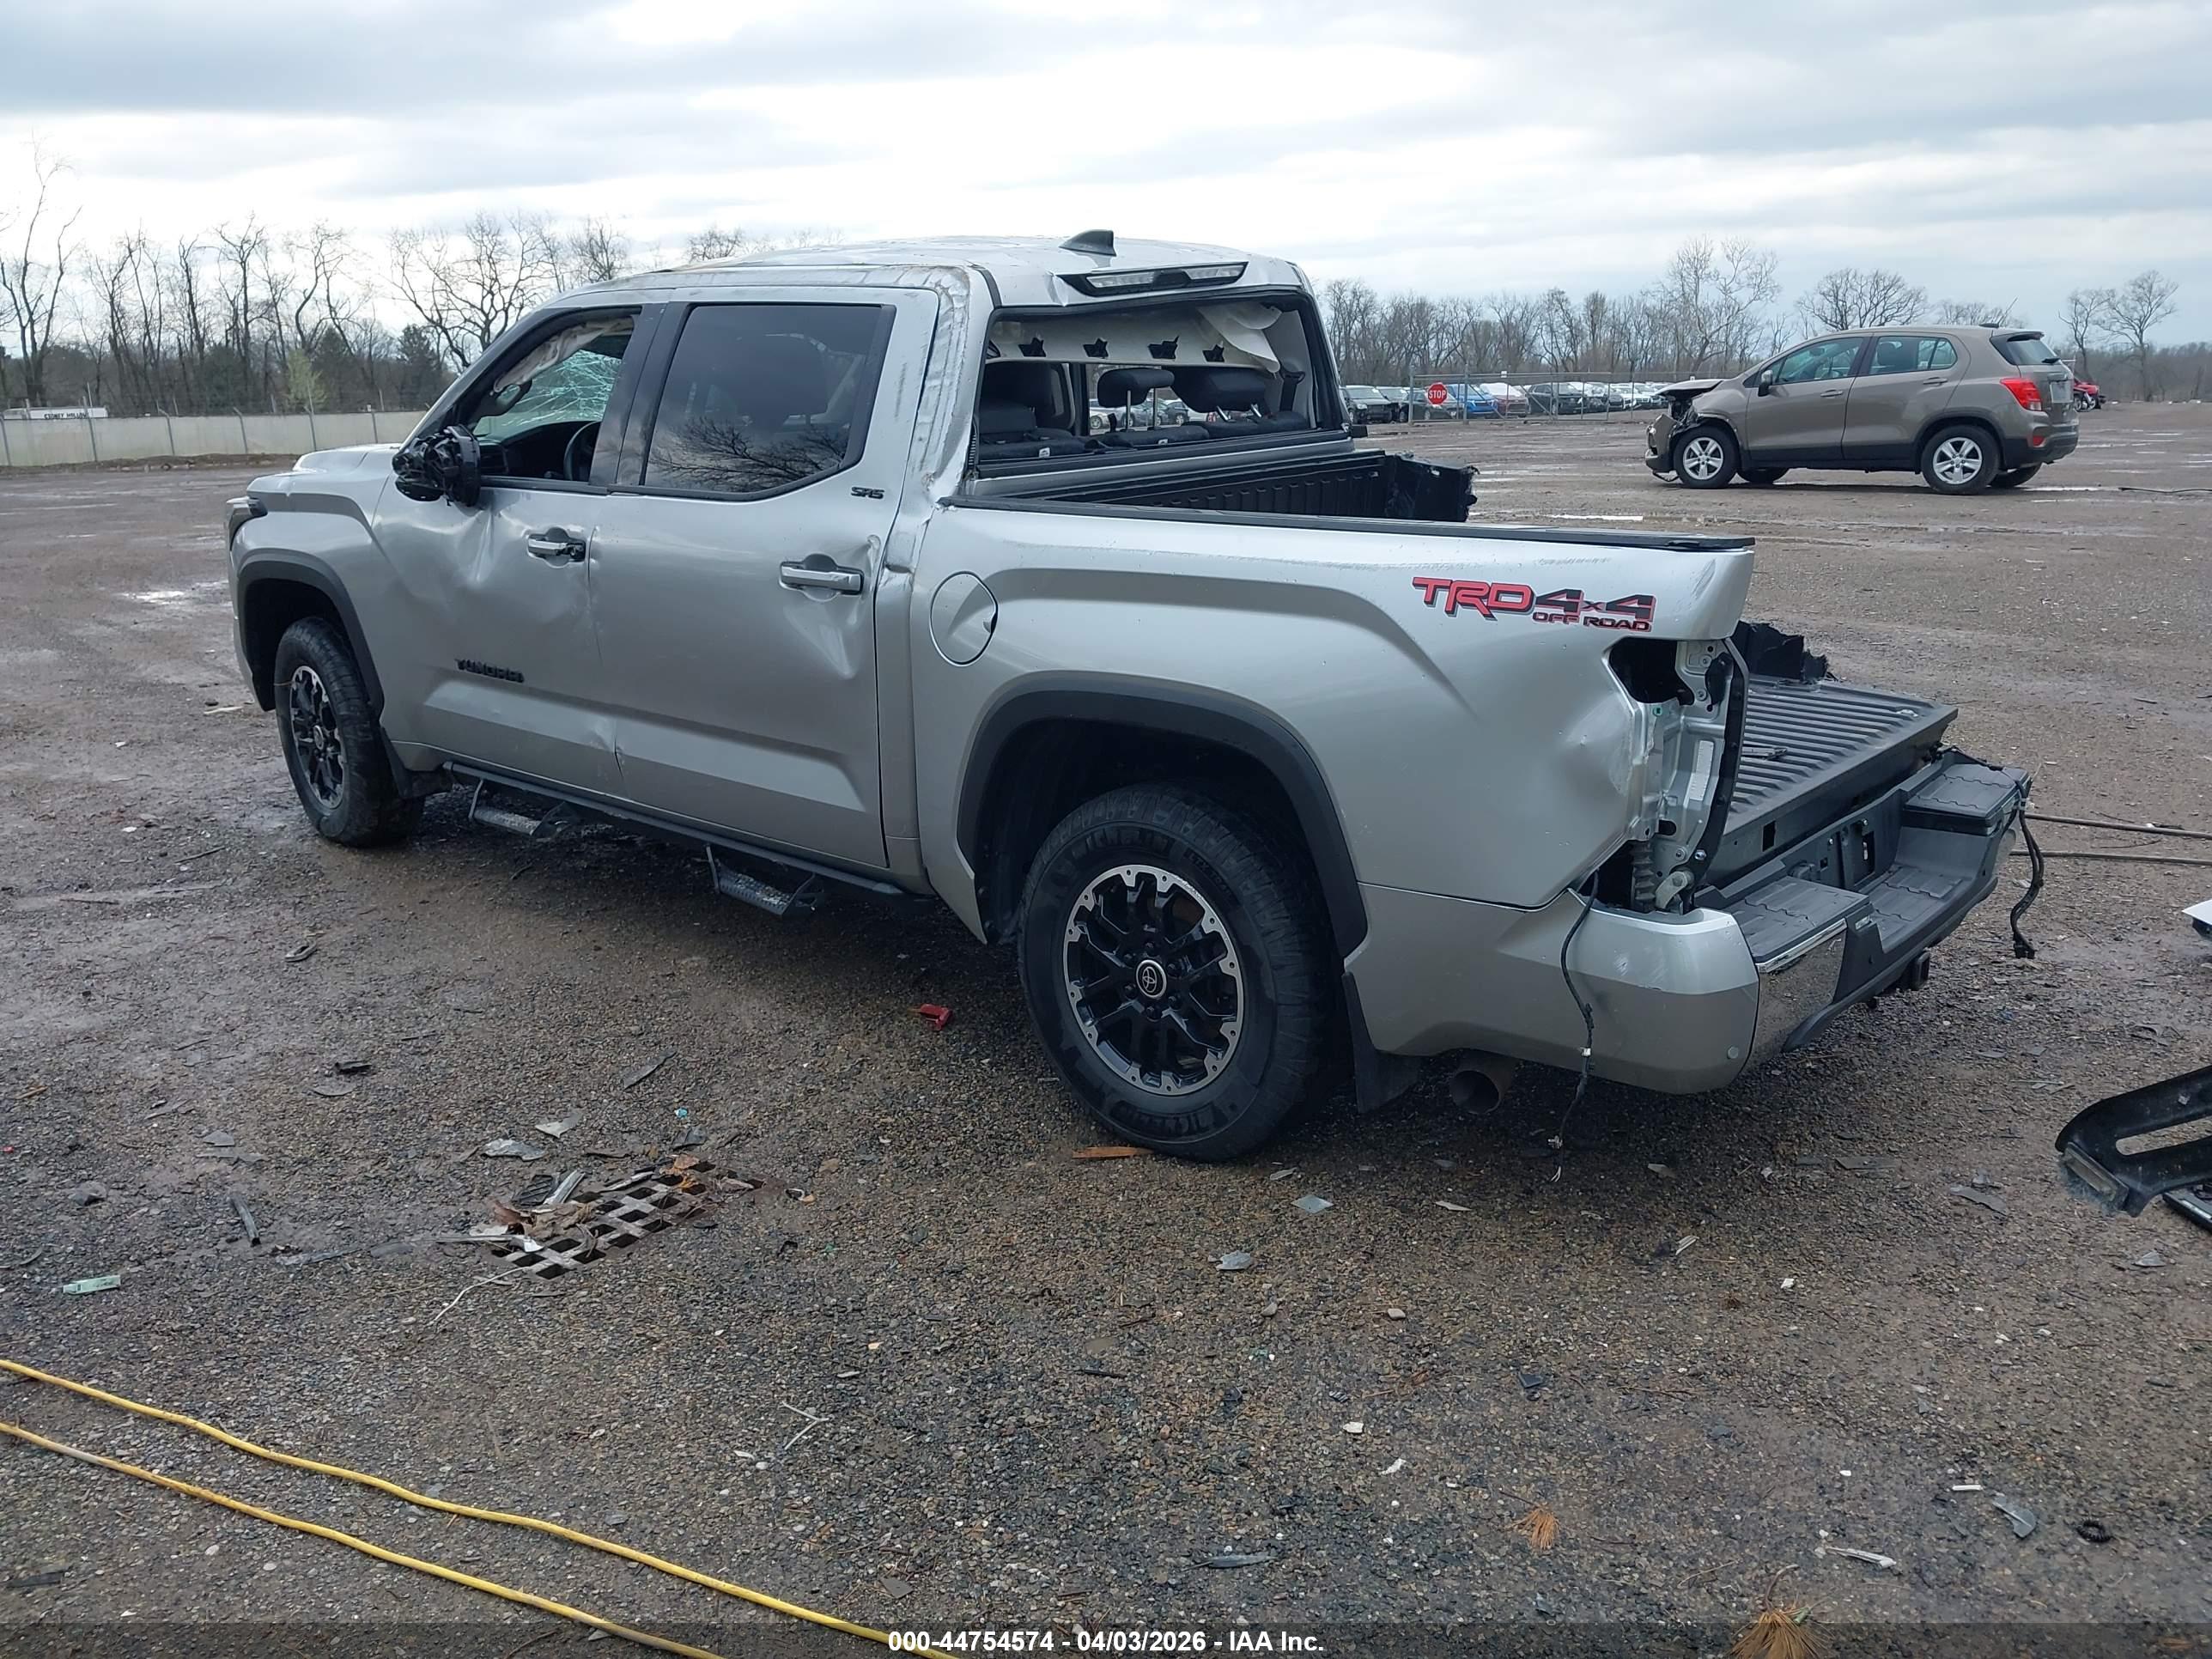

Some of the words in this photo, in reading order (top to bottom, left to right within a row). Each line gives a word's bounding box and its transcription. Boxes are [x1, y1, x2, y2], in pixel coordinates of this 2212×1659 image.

[1429, 390, 1446, 399] STOP
[851, 486, 884, 499] SR5
[1413, 576, 1535, 621] TRD
[1532, 611, 1580, 626] OFF
[1583, 616, 1651, 633] ROAD
